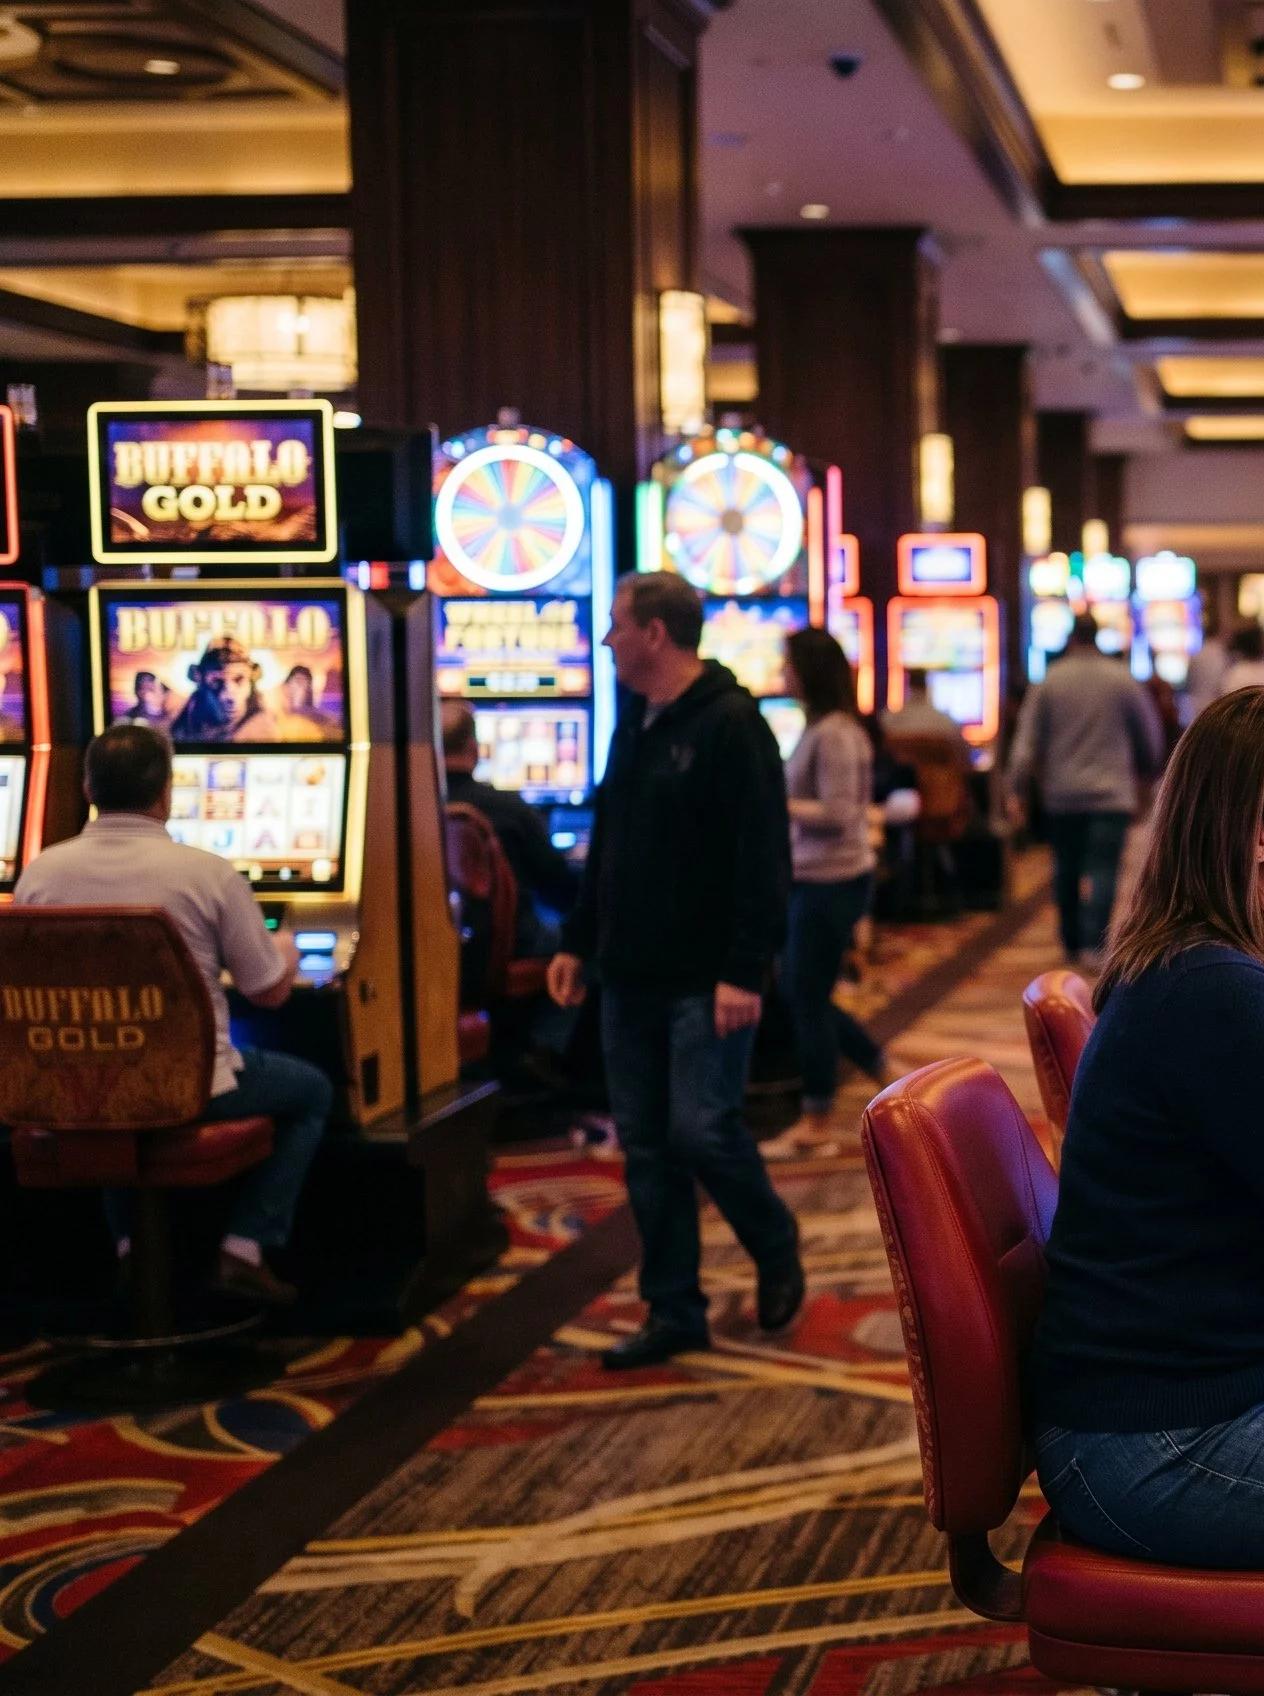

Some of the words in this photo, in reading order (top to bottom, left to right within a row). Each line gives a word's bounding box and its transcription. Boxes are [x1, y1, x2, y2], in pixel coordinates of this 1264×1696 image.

[113, 440, 312, 488] BUFFALO
[142, 485, 282, 522] GOLD
[116, 606, 332, 653] BUFFALO
